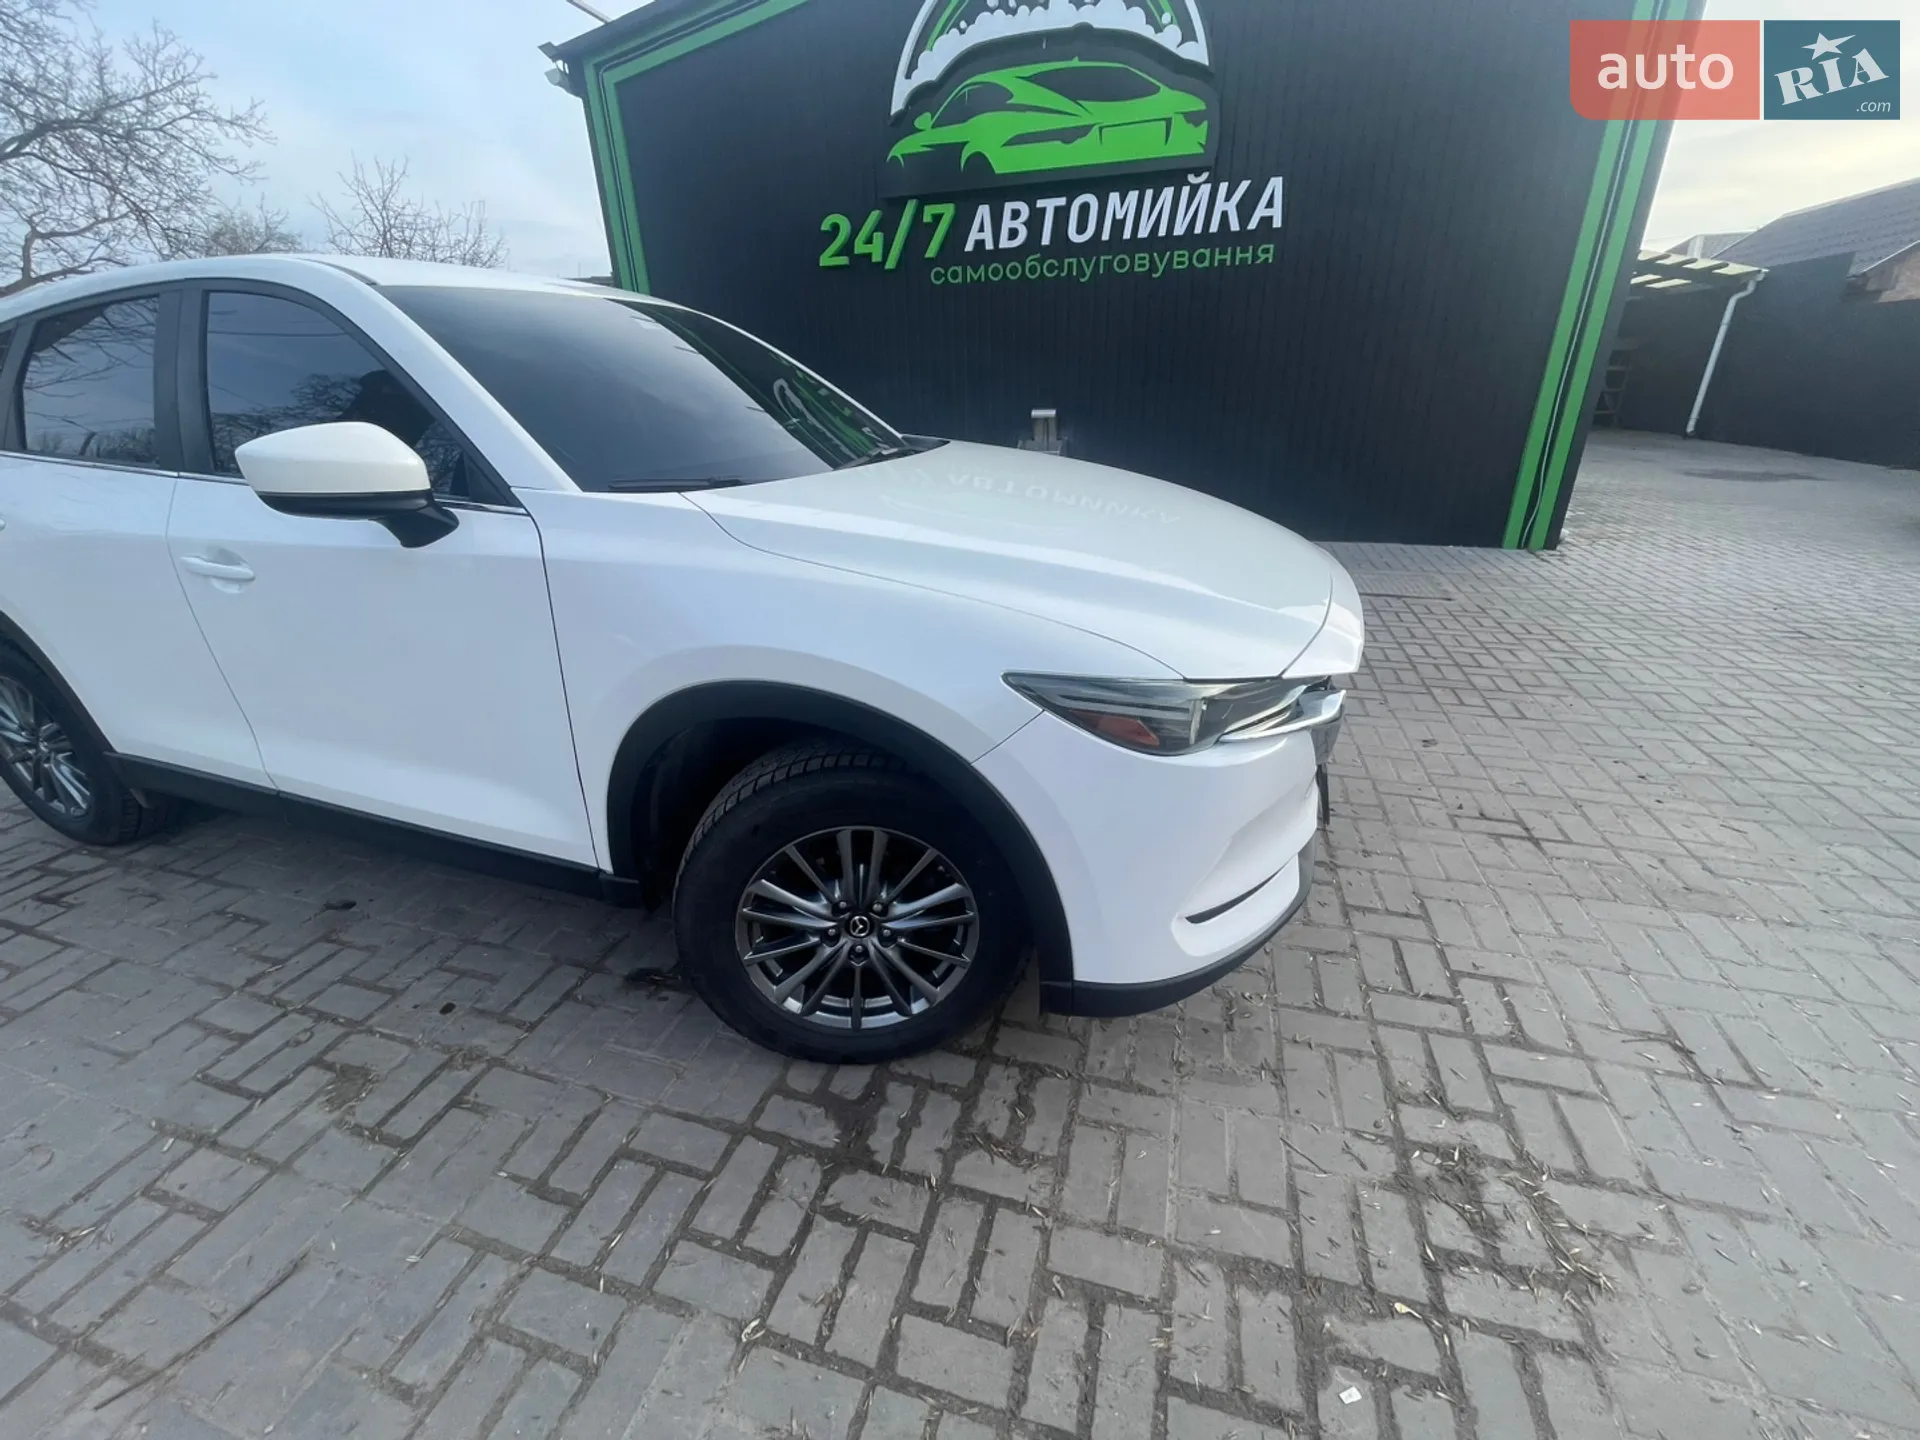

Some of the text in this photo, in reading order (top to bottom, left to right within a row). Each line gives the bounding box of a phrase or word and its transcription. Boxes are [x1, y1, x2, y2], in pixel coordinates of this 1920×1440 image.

[819, 172, 1284, 269] 24/7 АВТОМИЙКА
[930, 244, 1275, 285] самообслуговування
